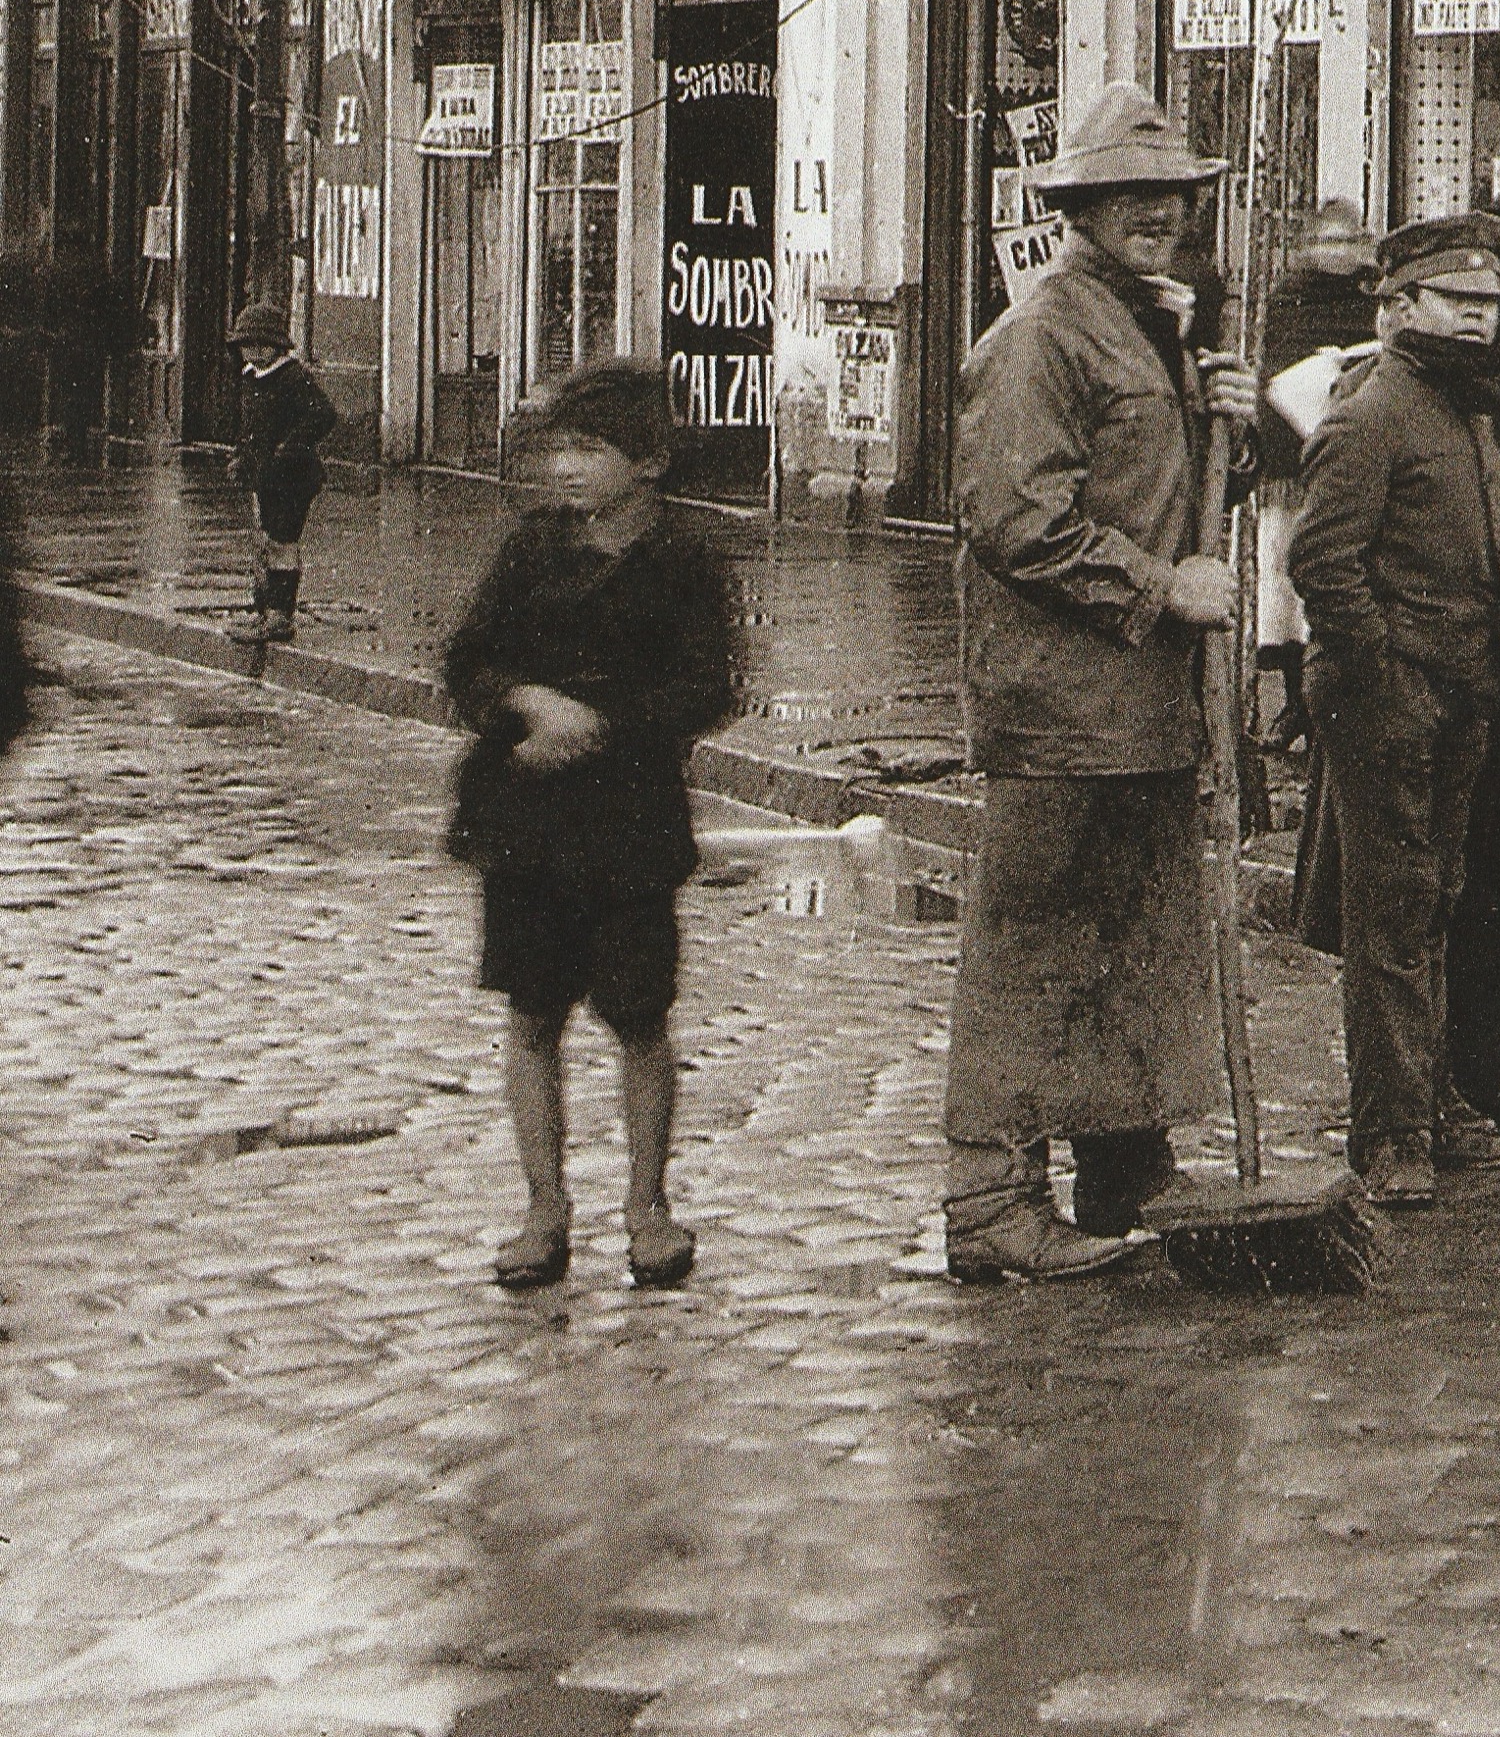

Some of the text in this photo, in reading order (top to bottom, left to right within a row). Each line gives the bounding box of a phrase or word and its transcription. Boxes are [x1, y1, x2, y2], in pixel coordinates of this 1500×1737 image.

[333, 95, 360, 146] EL
[691, 183, 758, 228] LA
[792, 159, 830, 214] LA
